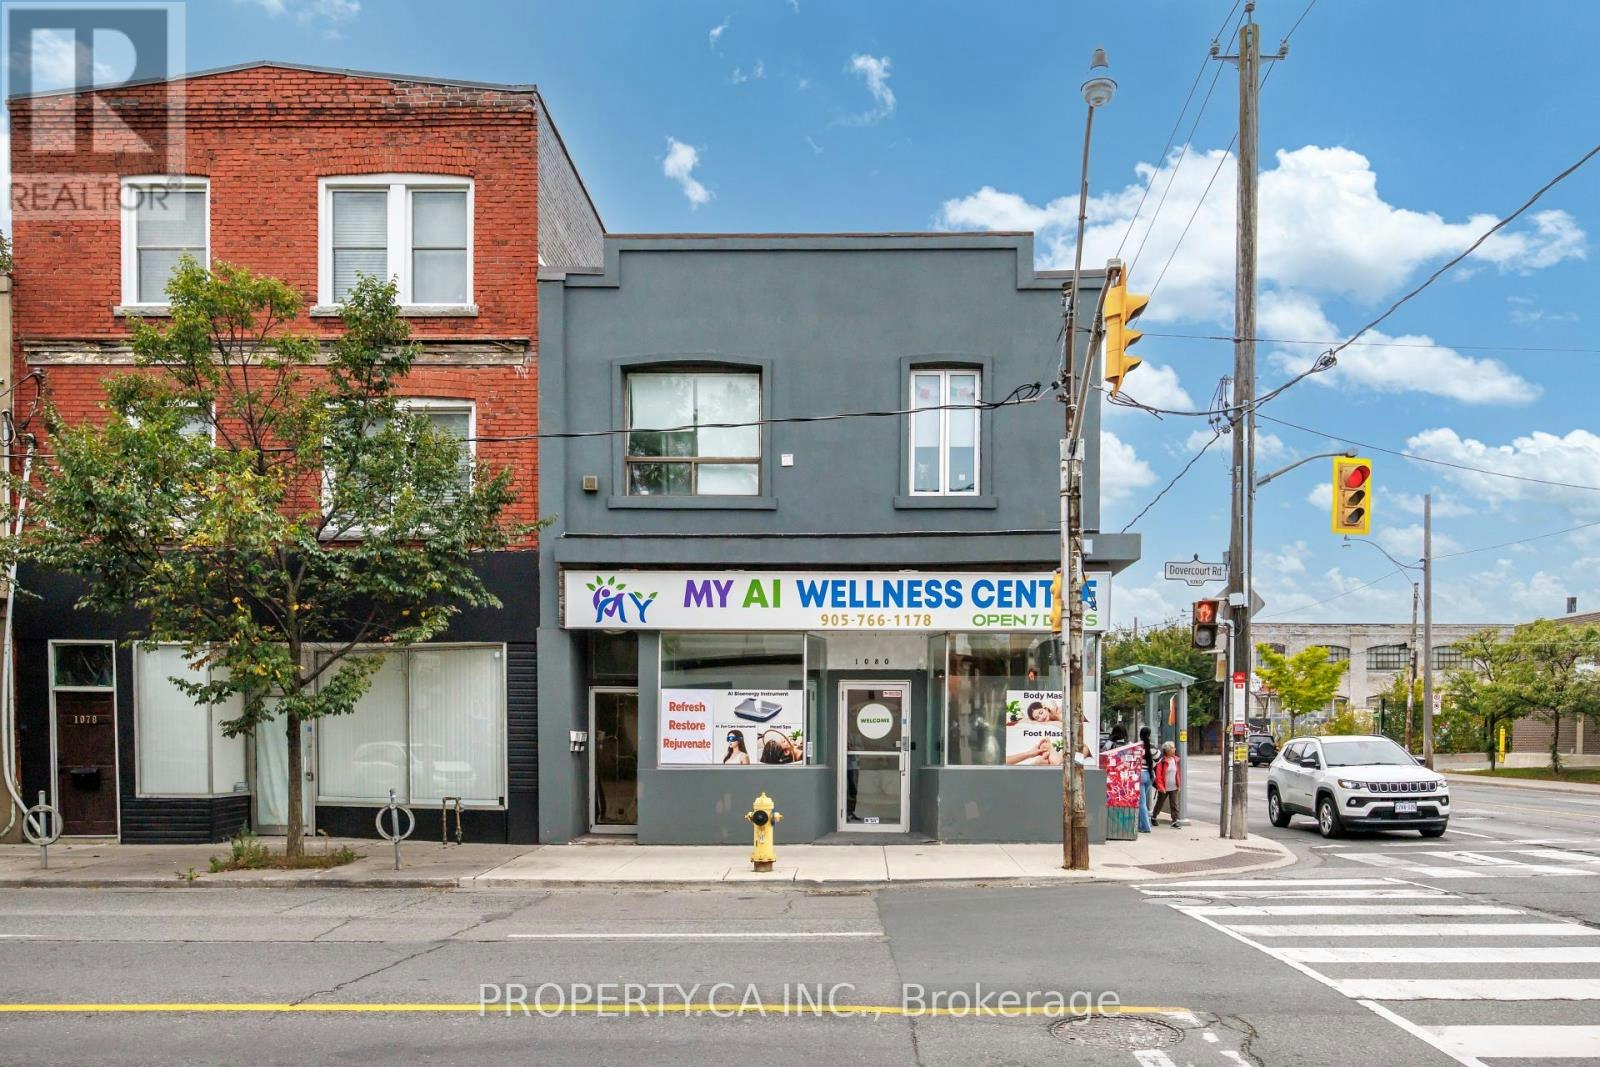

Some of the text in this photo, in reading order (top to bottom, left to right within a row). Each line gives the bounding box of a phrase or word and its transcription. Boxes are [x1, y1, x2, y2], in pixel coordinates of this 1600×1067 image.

[1169, 565, 1222, 577] Dovercourt Rd
[683, 579, 1097, 609] MY AI WELLNESS CENTE
[820, 614, 932, 627] 905-766-1178
[972, 614, 1027, 627] OPEN
[1031, 614, 1039, 627] 7
[1023, 692, 1045, 700] Body
[669, 701, 706, 712] Refresh
[74, 715, 97, 724] 1078
[669, 719, 706, 730] Restore
[663, 738, 712, 750] Rejuvenate
